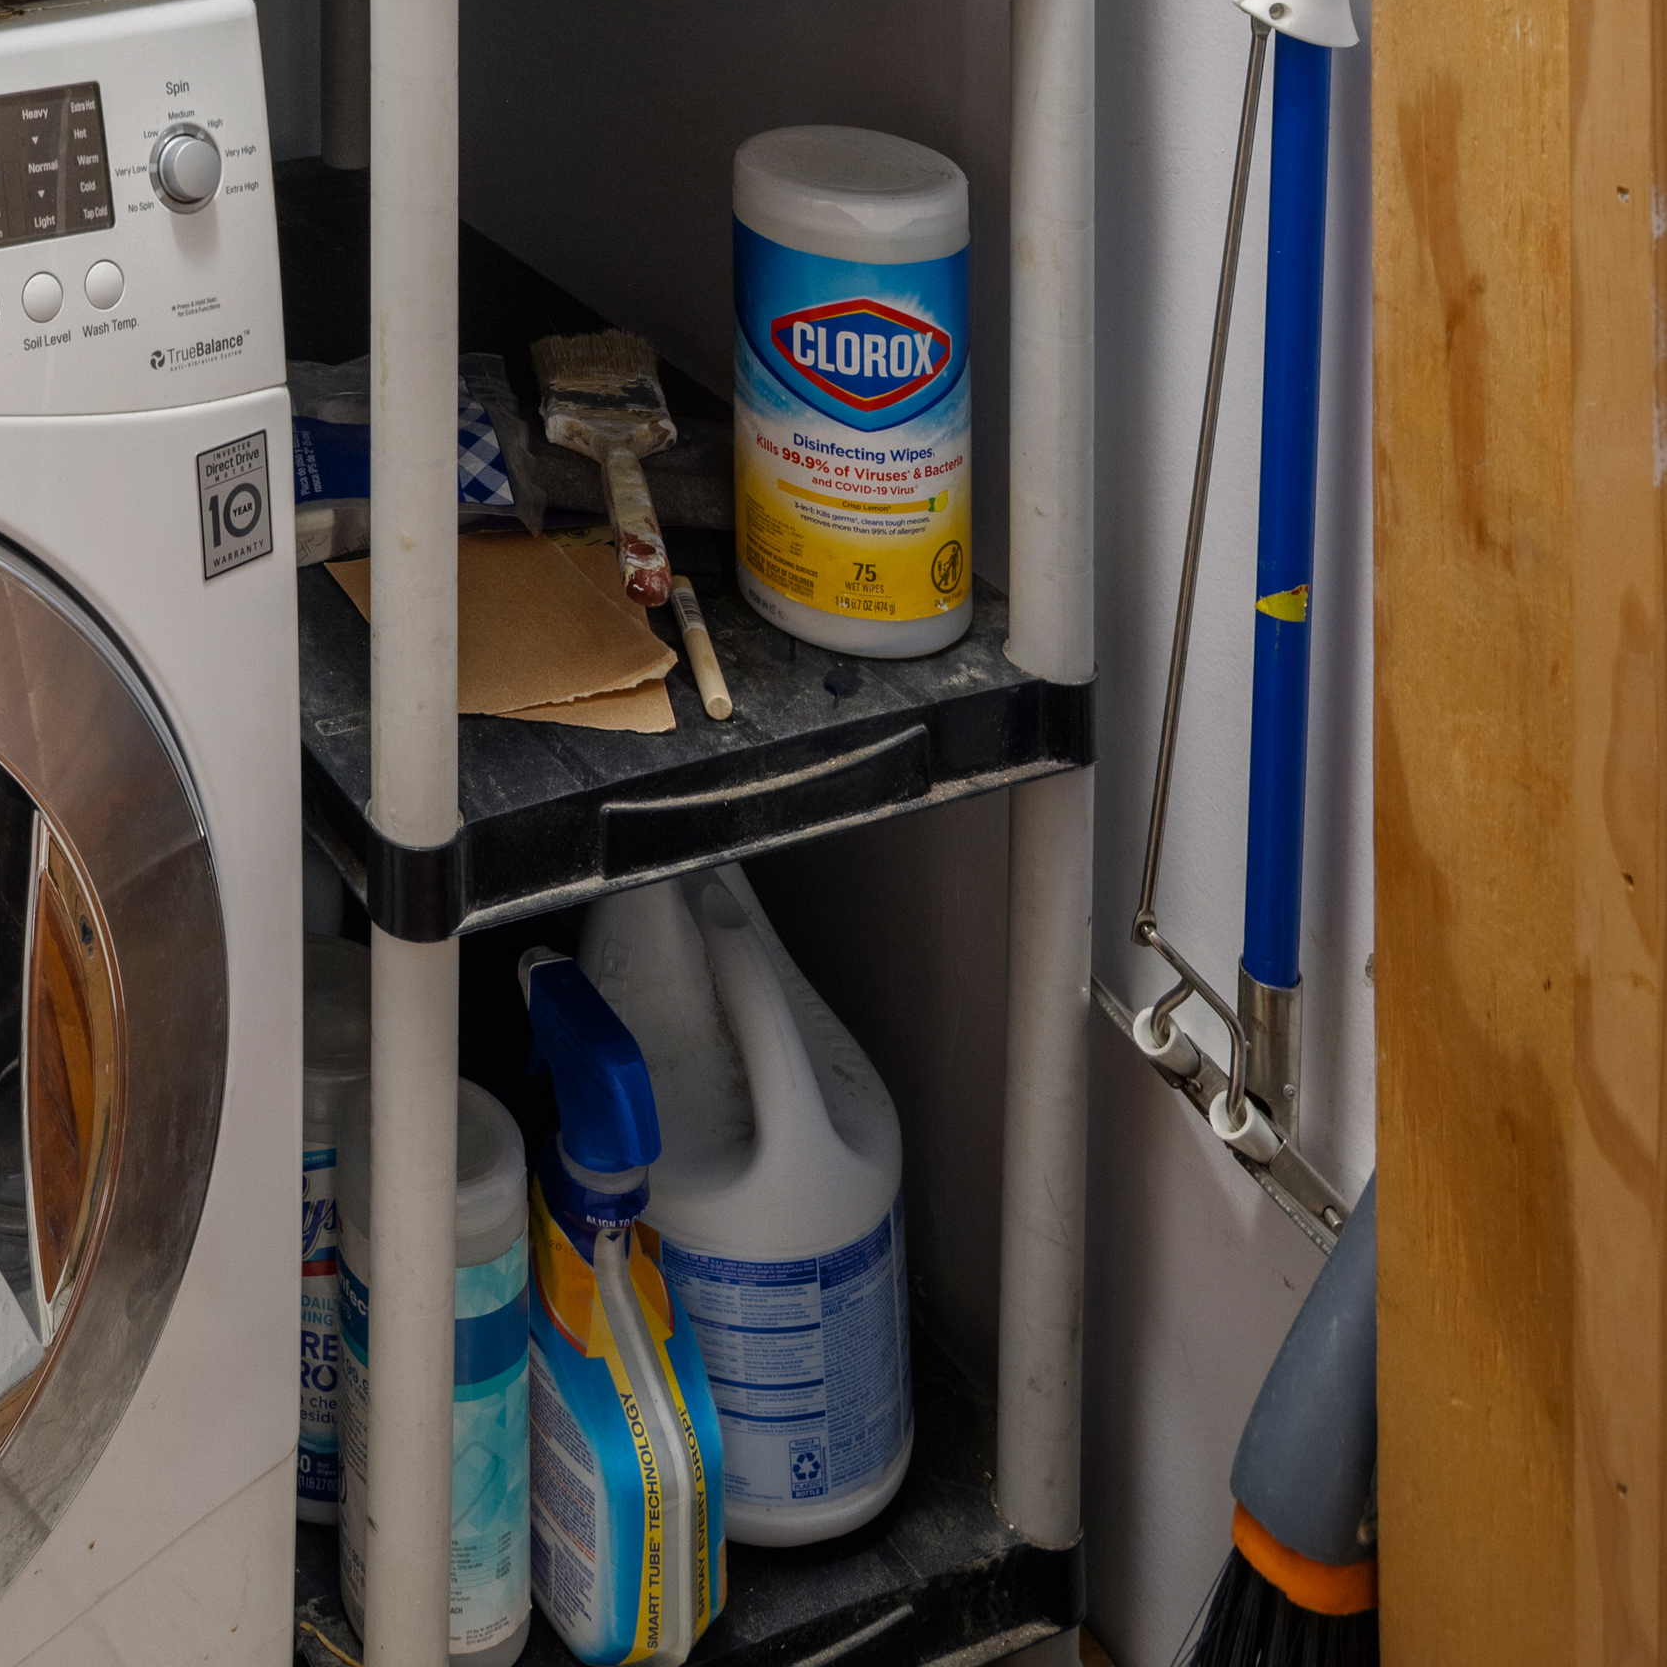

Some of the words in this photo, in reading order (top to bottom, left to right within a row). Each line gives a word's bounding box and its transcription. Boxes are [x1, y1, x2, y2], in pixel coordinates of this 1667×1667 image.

[166, 80, 190, 97] Spin
[22, 108, 48, 120] Heavy
[168, 109, 195, 121] Medium
[207, 118, 223, 129] High
[73, 129, 87, 140] Hot
[143, 129, 159, 139] Low
[225, 147, 241, 158] Very
[241, 144, 257, 155] High
[28, 160, 58, 174] Normal
[77, 154, 99, 166] Warm
[115, 168, 131, 177] Very
[132, 165, 148, 174] Low
[80, 181, 96, 193] Cold
[226, 184, 244, 195] Extra
[244, 181, 260, 192] High
[83, 209, 94, 221] Tap
[94, 206, 108, 217] Cold
[128, 204, 138, 213] No
[139, 201, 155, 212] Spin
[34, 215, 56, 229] Light
[82, 321, 110, 338] Wash
[111, 317, 140, 333] Temp.
[23, 334, 43, 351] Soil
[44, 330, 72, 347] Level
[793, 321, 934, 378] CLOROX
[213, 441, 251, 461] INVERTER
[794, 433, 885, 464] Disinfecting
[890, 448, 934, 464] Wipes
[206, 457, 235, 477] Direct
[236, 448, 260, 465] Drive
[757, 434, 779, 455] Kills
[782, 448, 830, 473] 99.9%
[834, 466, 850, 478] of
[913, 469, 922, 480] &
[924, 454, 963, 478] Bacteria
[215, 463, 253, 482] MOTOR
[835, 481, 888, 495] COVID-19
[233, 502, 253, 517] YEAR
[842, 501, 862, 511] Crisp
[208, 482, 262, 548] 10
[800, 514, 831, 528] removes
[832, 522, 852, 532] more
[853, 525, 870, 535] than
[213, 539, 264, 567] WARRANTY
[852, 562, 877, 583] 75
[845, 582, 860, 592] WET
[862, 583, 885, 593] WIPES
[586, 1215, 616, 1227] ALIGN
[619, 1219, 630, 1227] TO
[620, 1393, 661, 1532] TECHNOLOGY
[794, 1481, 821, 1490] PLASTIC
[795, 1489, 820, 1498] BOTTLE
[698, 1490, 706, 1553] EVERY
[698, 1557, 706, 1618] SPRAY
[647, 1592, 660, 1649] SMART
